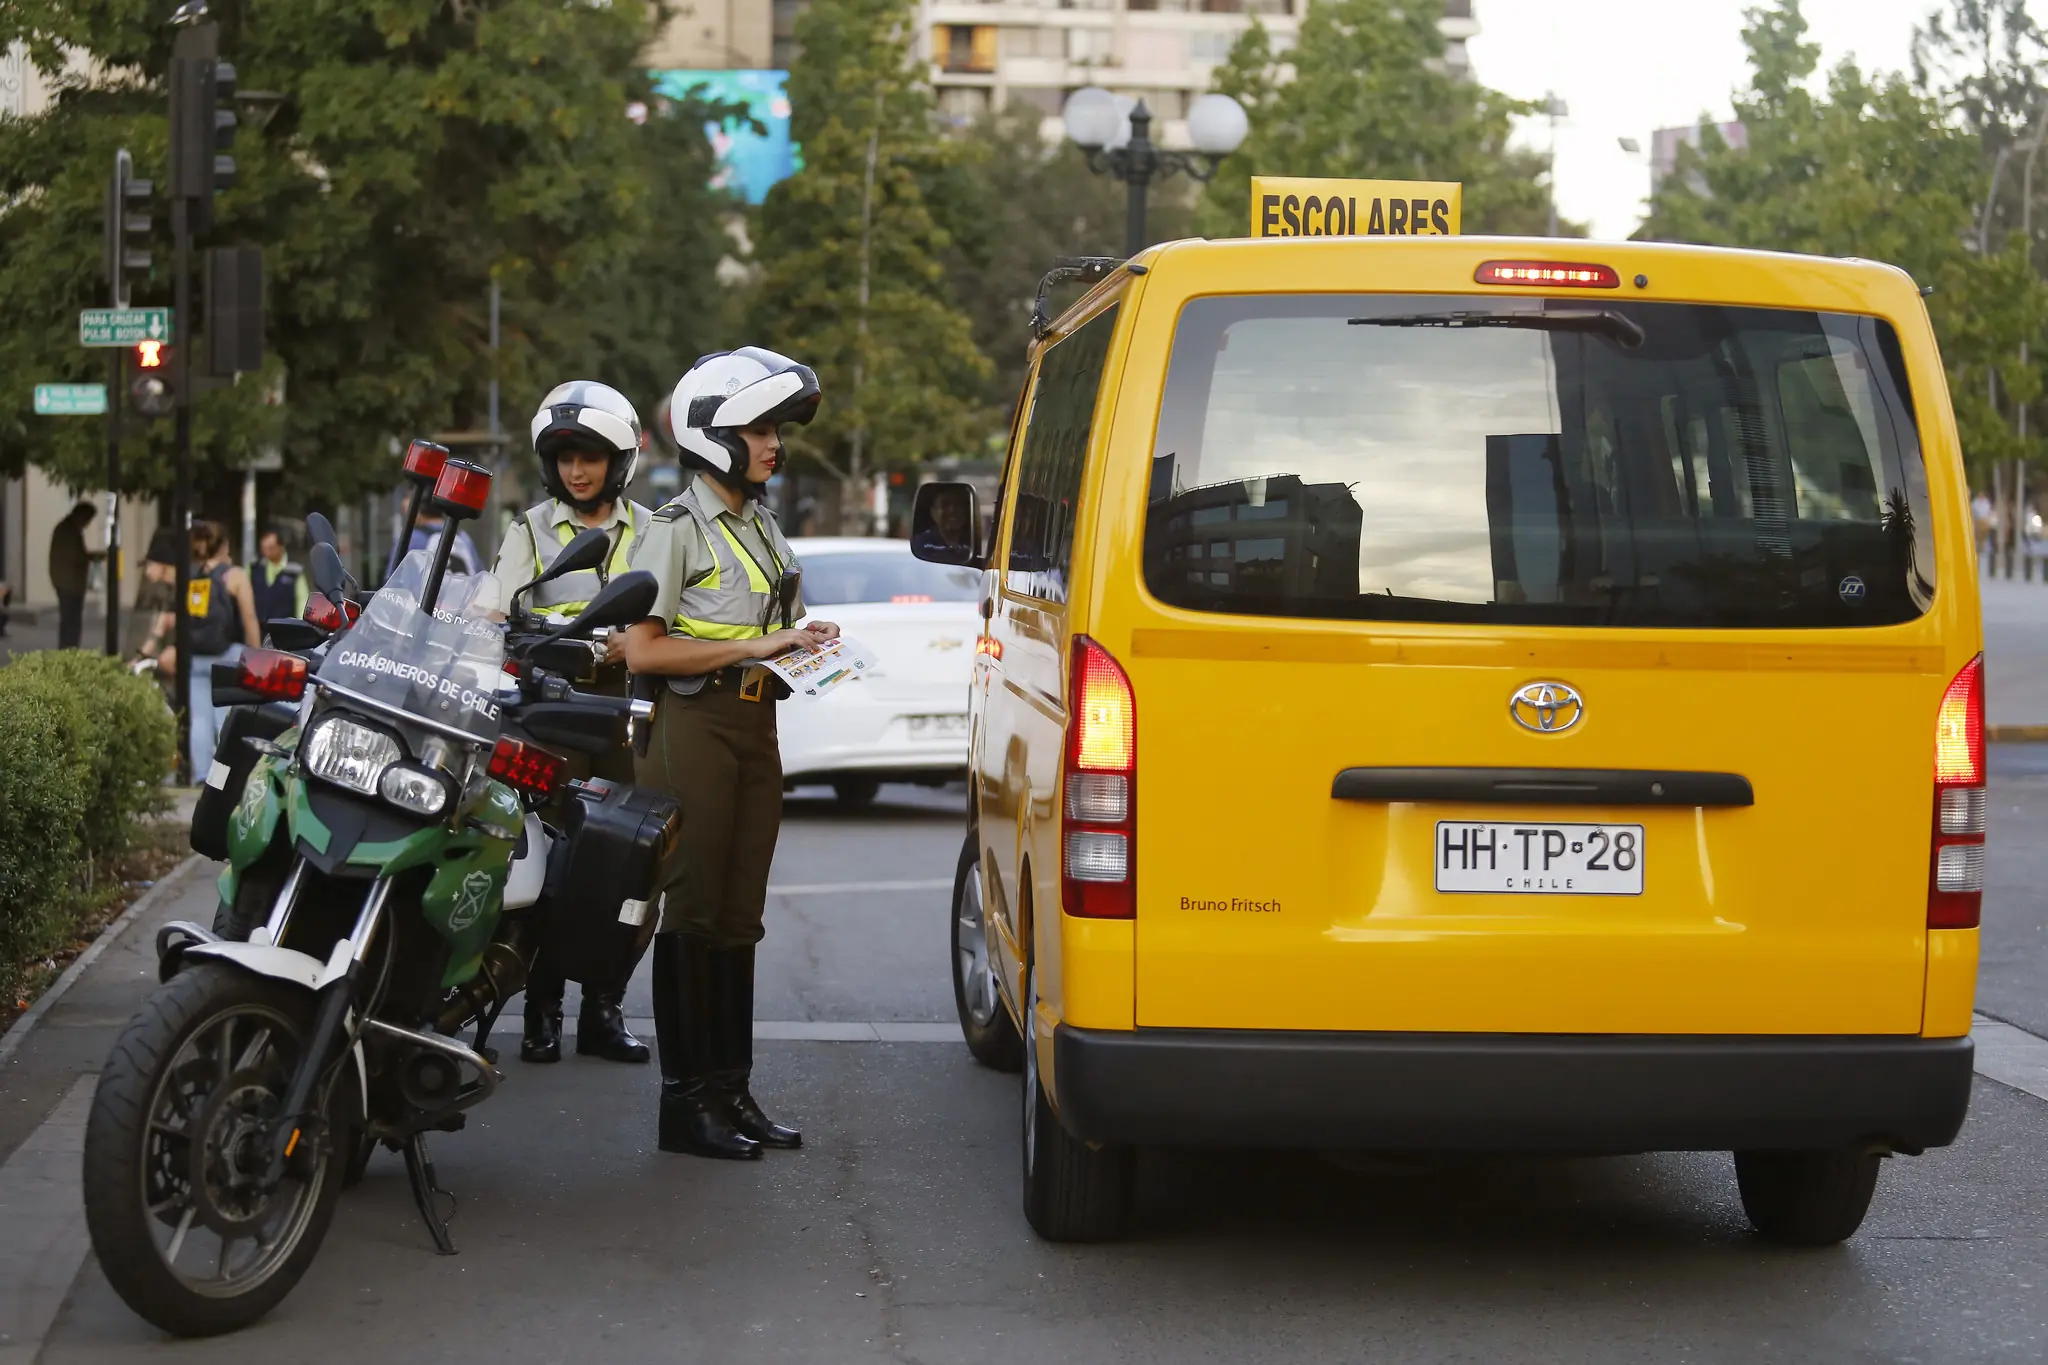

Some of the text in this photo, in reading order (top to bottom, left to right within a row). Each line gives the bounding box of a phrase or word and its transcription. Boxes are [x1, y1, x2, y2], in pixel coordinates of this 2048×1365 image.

[1262, 194, 1449, 236] ESCOLARES
[338, 650, 500, 721] CARABINEROS DE CHILE
[1506, 878, 1573, 888] CHILE
[1180, 897, 1281, 912] Bruno Fritsch
